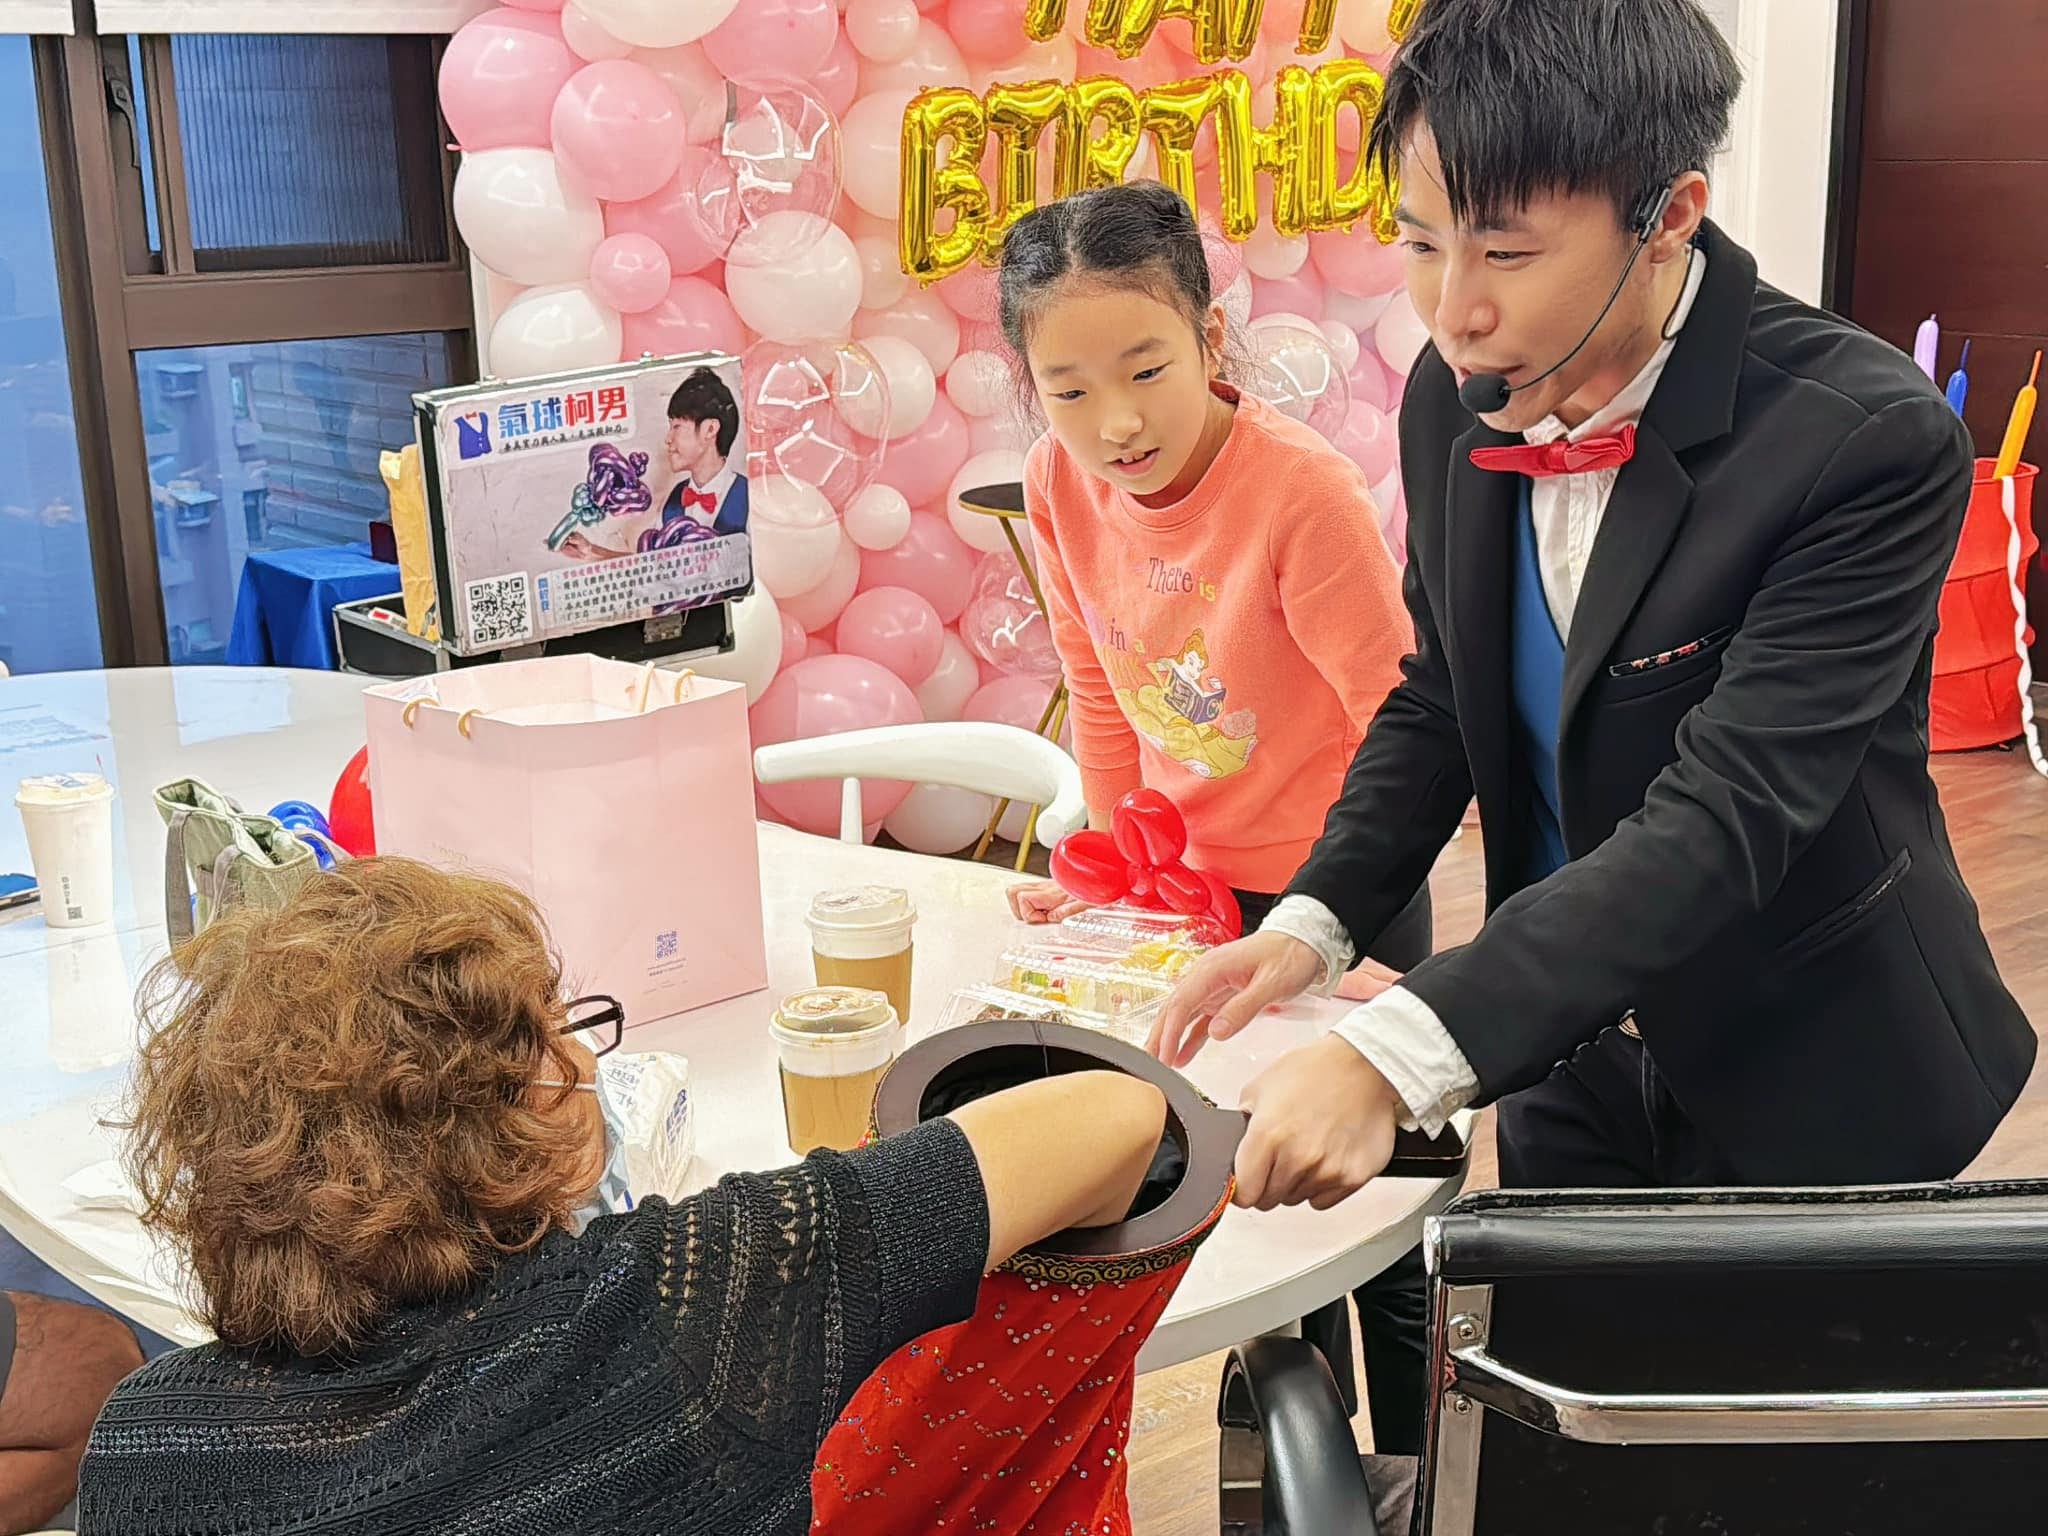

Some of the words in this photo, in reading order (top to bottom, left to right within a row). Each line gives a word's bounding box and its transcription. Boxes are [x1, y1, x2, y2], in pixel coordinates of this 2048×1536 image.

[899, 56, 1400, 289] BIRTHD
[498, 386, 627, 439] 氣球柯男
[1146, 557, 1194, 594] There
[1199, 575, 1217, 602] is
[1110, 617, 1128, 652] in
